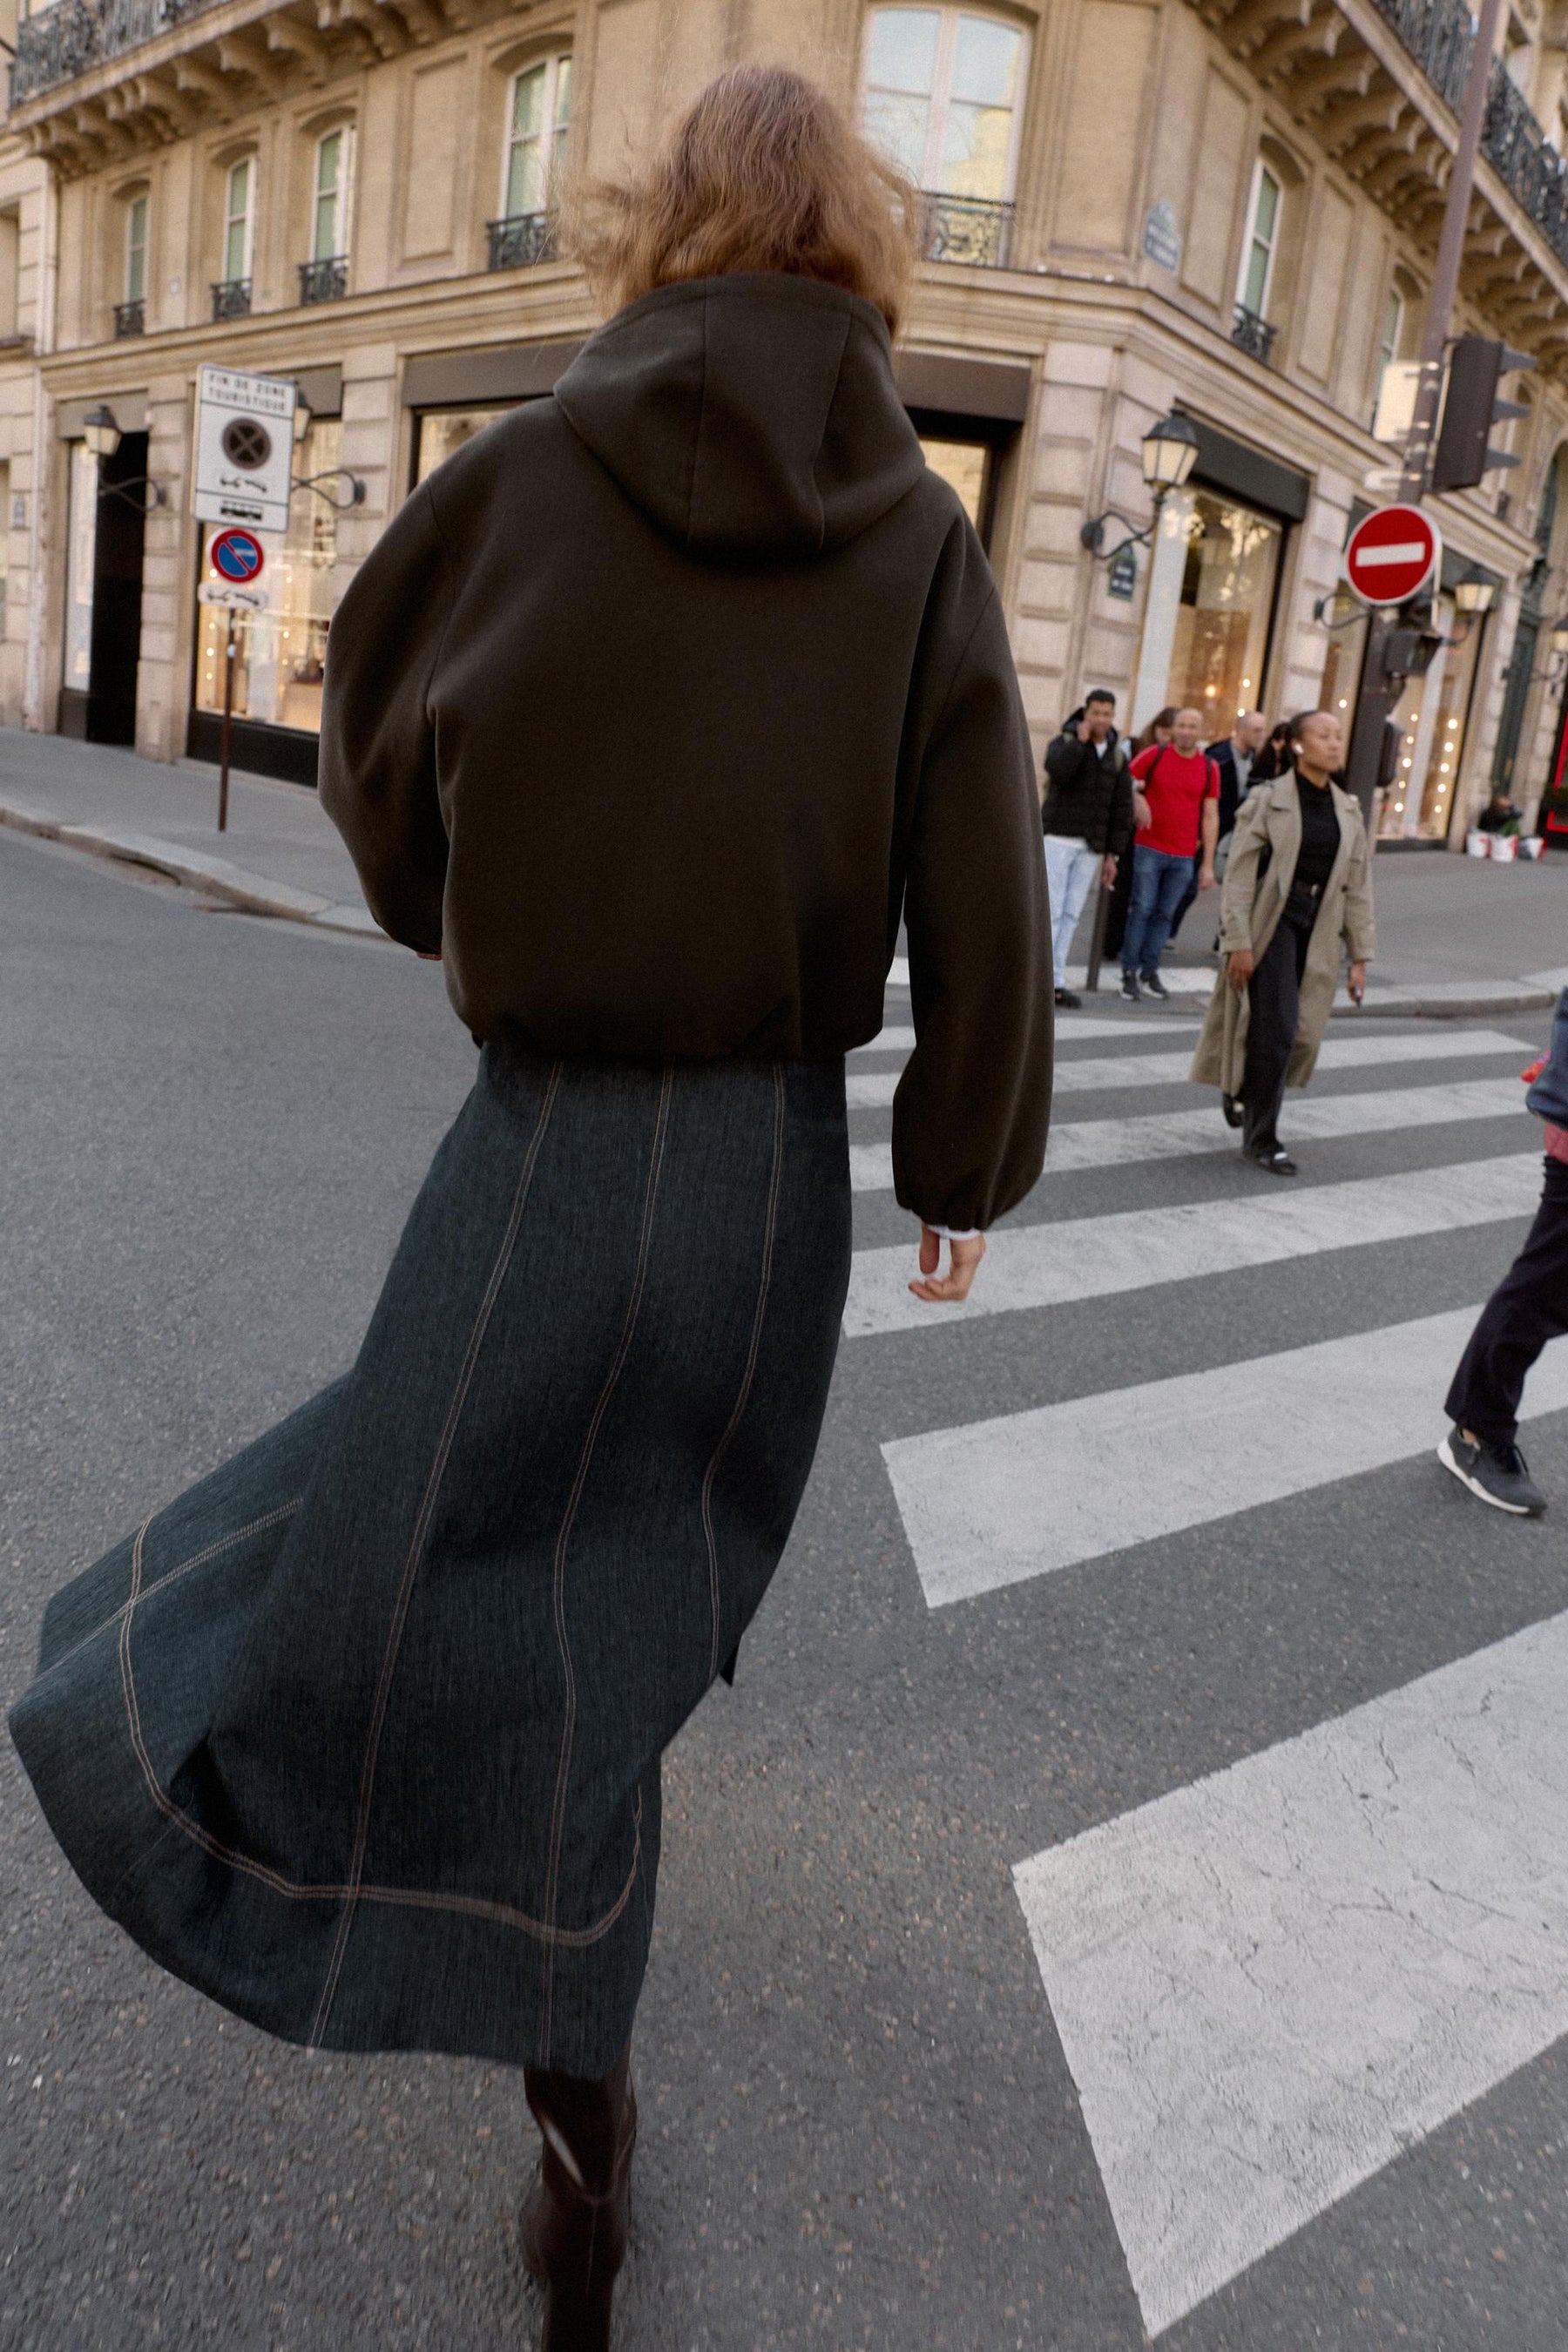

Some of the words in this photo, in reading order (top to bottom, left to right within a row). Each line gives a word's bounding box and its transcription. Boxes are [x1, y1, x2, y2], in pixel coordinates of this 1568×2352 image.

[209, 373, 228, 384] FIN
[235, 378, 248, 389] DE
[256, 382, 285, 396] ZONE
[209, 387, 285, 410] TOURISTIQUE
